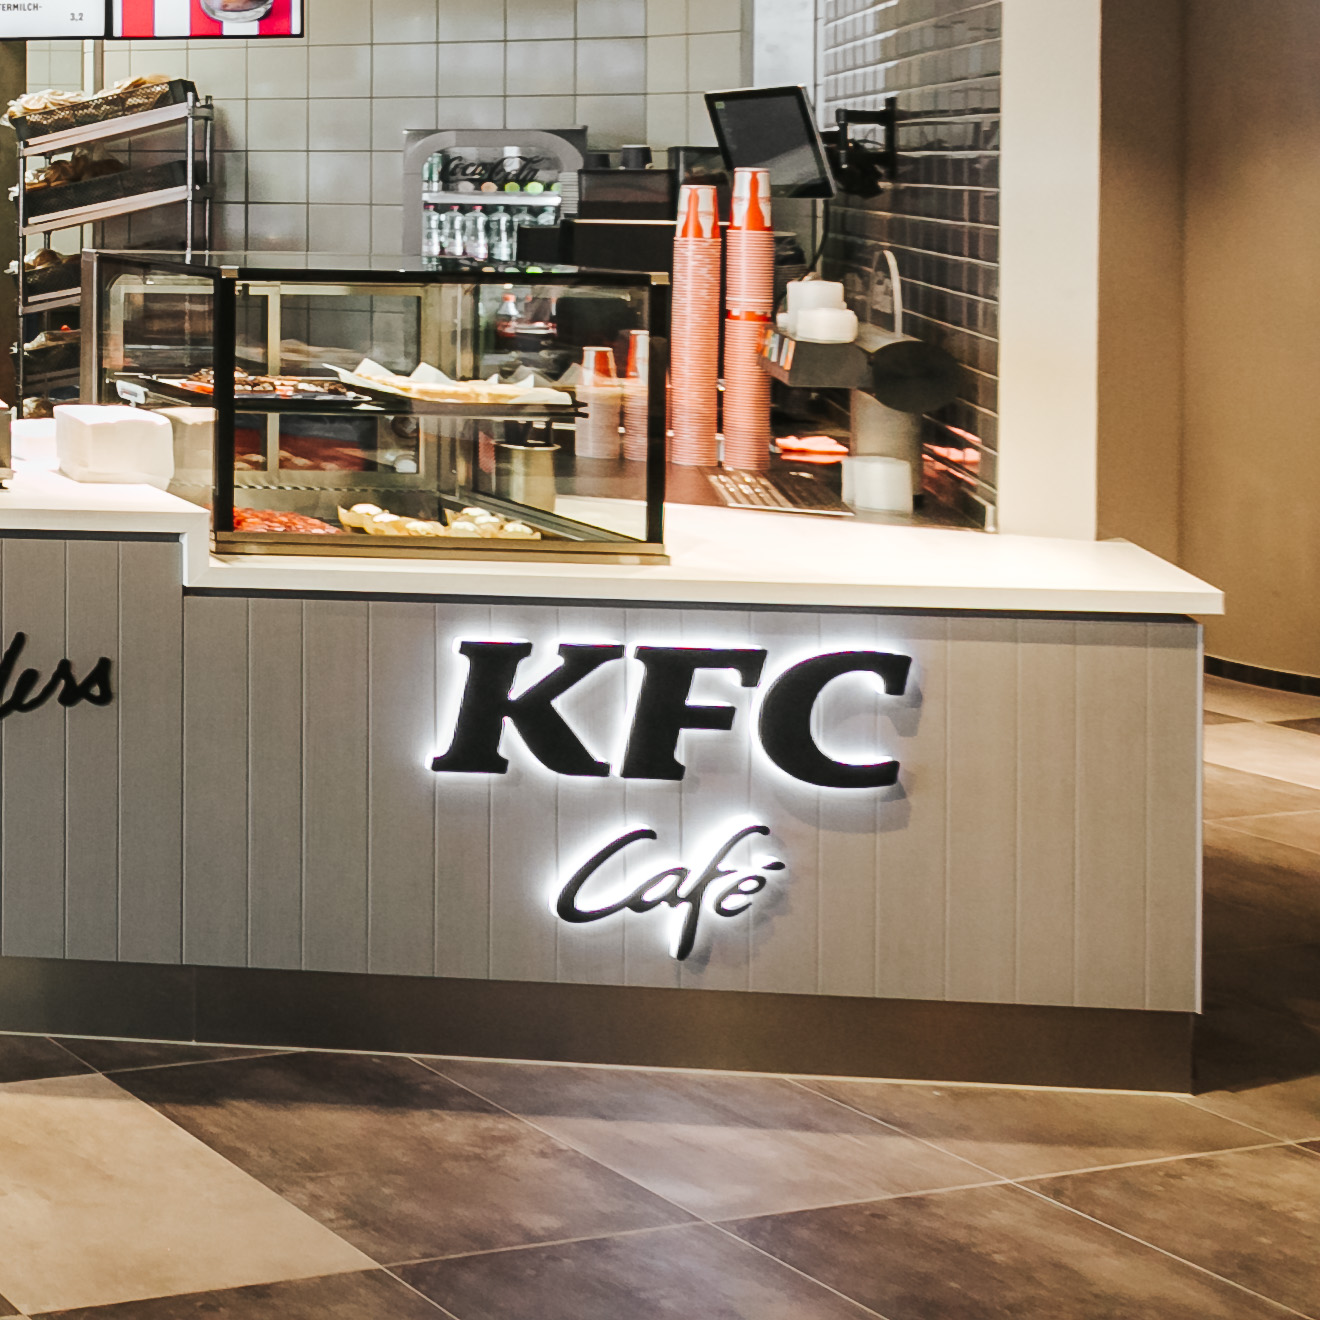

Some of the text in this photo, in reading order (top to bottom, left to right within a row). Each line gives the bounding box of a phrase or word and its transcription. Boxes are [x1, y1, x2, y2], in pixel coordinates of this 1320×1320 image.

[70, 13, 84, 21] 3,2
[431, 640, 912, 788] KFC
[556, 824, 786, 962] Café
